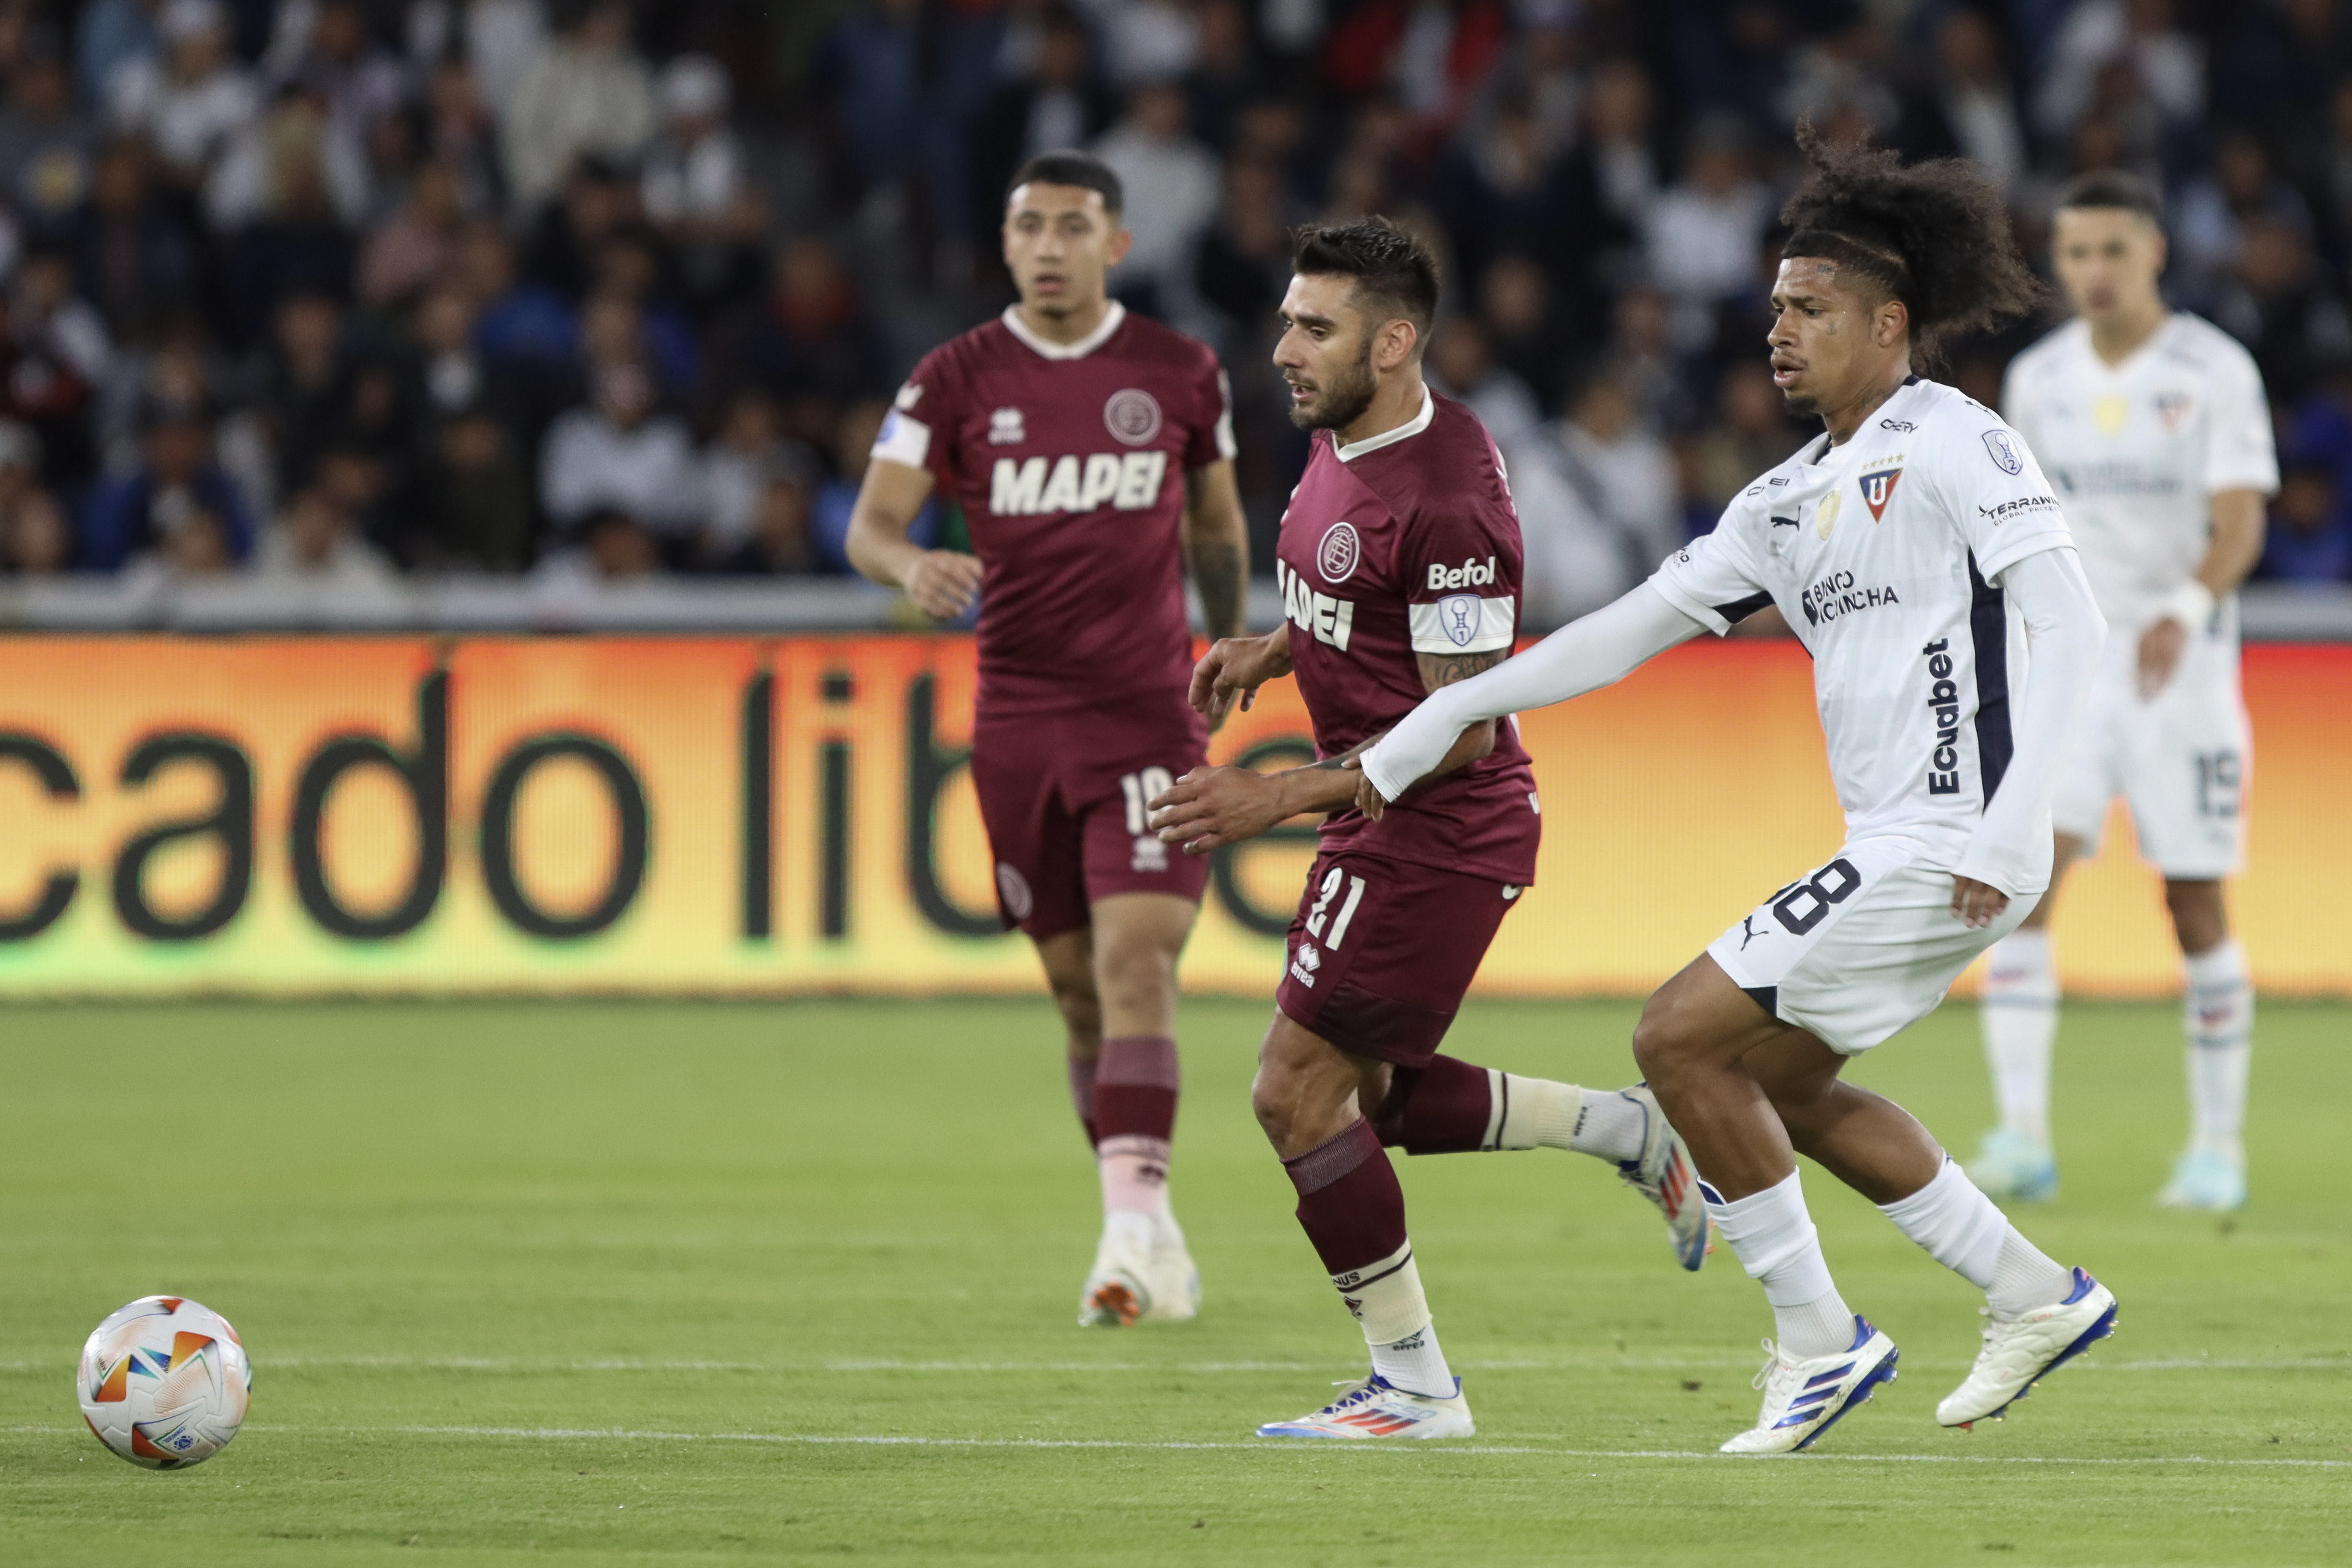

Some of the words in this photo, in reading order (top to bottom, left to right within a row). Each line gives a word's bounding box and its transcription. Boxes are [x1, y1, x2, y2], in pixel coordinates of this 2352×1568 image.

[2008, 459, 2017, 470] 2
[990, 451, 1167, 516] MAPEI
[1870, 477, 1888, 506] U
[1993, 510, 2024, 526] GLOBAL
[1427, 556, 1496, 591] Befol
[1458, 631, 1464, 641] 1
[1923, 637, 1960, 795] Ecuabet
[1306, 867, 1366, 951] 21
[1763, 858, 1861, 936] 8
[1291, 961, 1315, 988] errea
